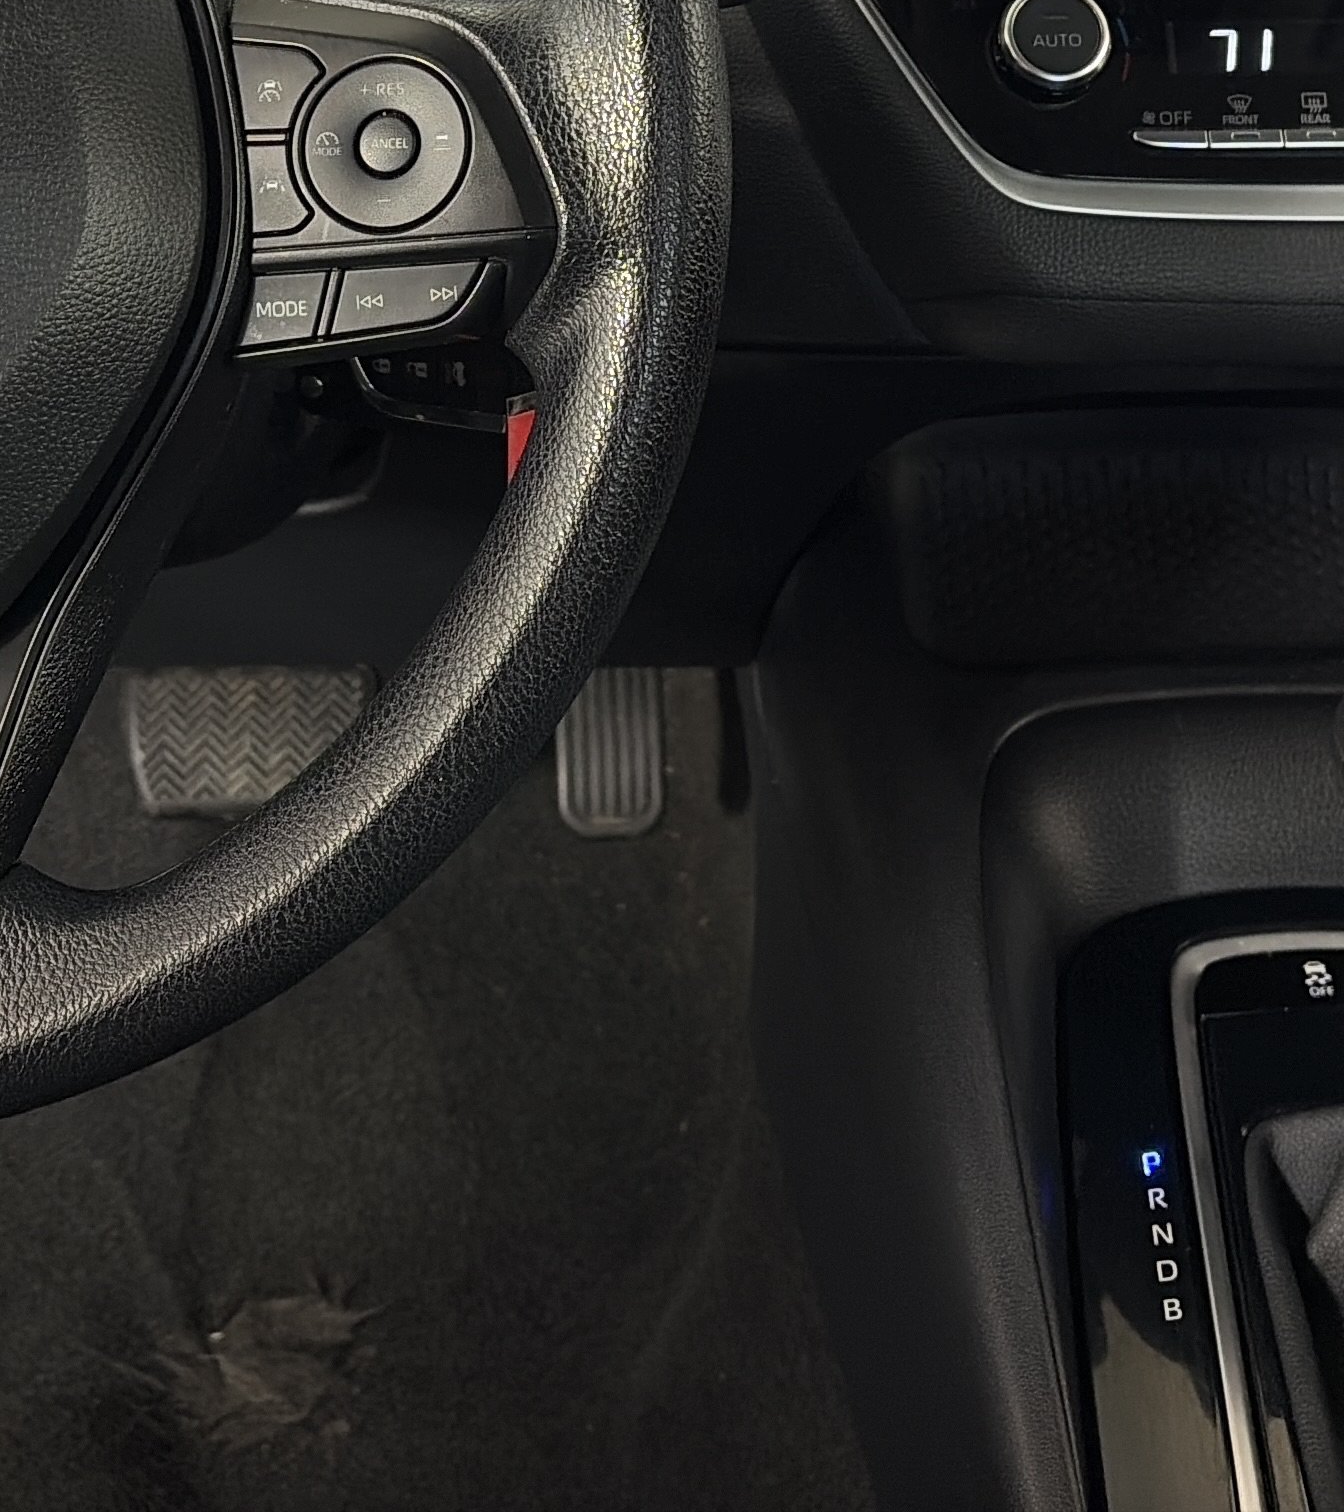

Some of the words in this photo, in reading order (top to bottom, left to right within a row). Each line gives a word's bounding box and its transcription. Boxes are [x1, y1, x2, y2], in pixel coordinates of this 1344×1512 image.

[1032, 33, 1082, 48] AUTO
[1209, 28, 1274, 72] 71
[1159, 110, 1193, 126] OFF
[1222, 114, 1259, 126] FRONT
[1300, 113, 1332, 125] REAR
[312, 146, 343, 157] MODE
[256, 300, 308, 318] MODE
[1141, 1150, 1162, 1177] P
[1147, 1187, 1169, 1211] R
[1151, 1221, 1175, 1246] N
[1156, 1259, 1179, 1283] D
[1162, 1298, 1183, 1321] B
